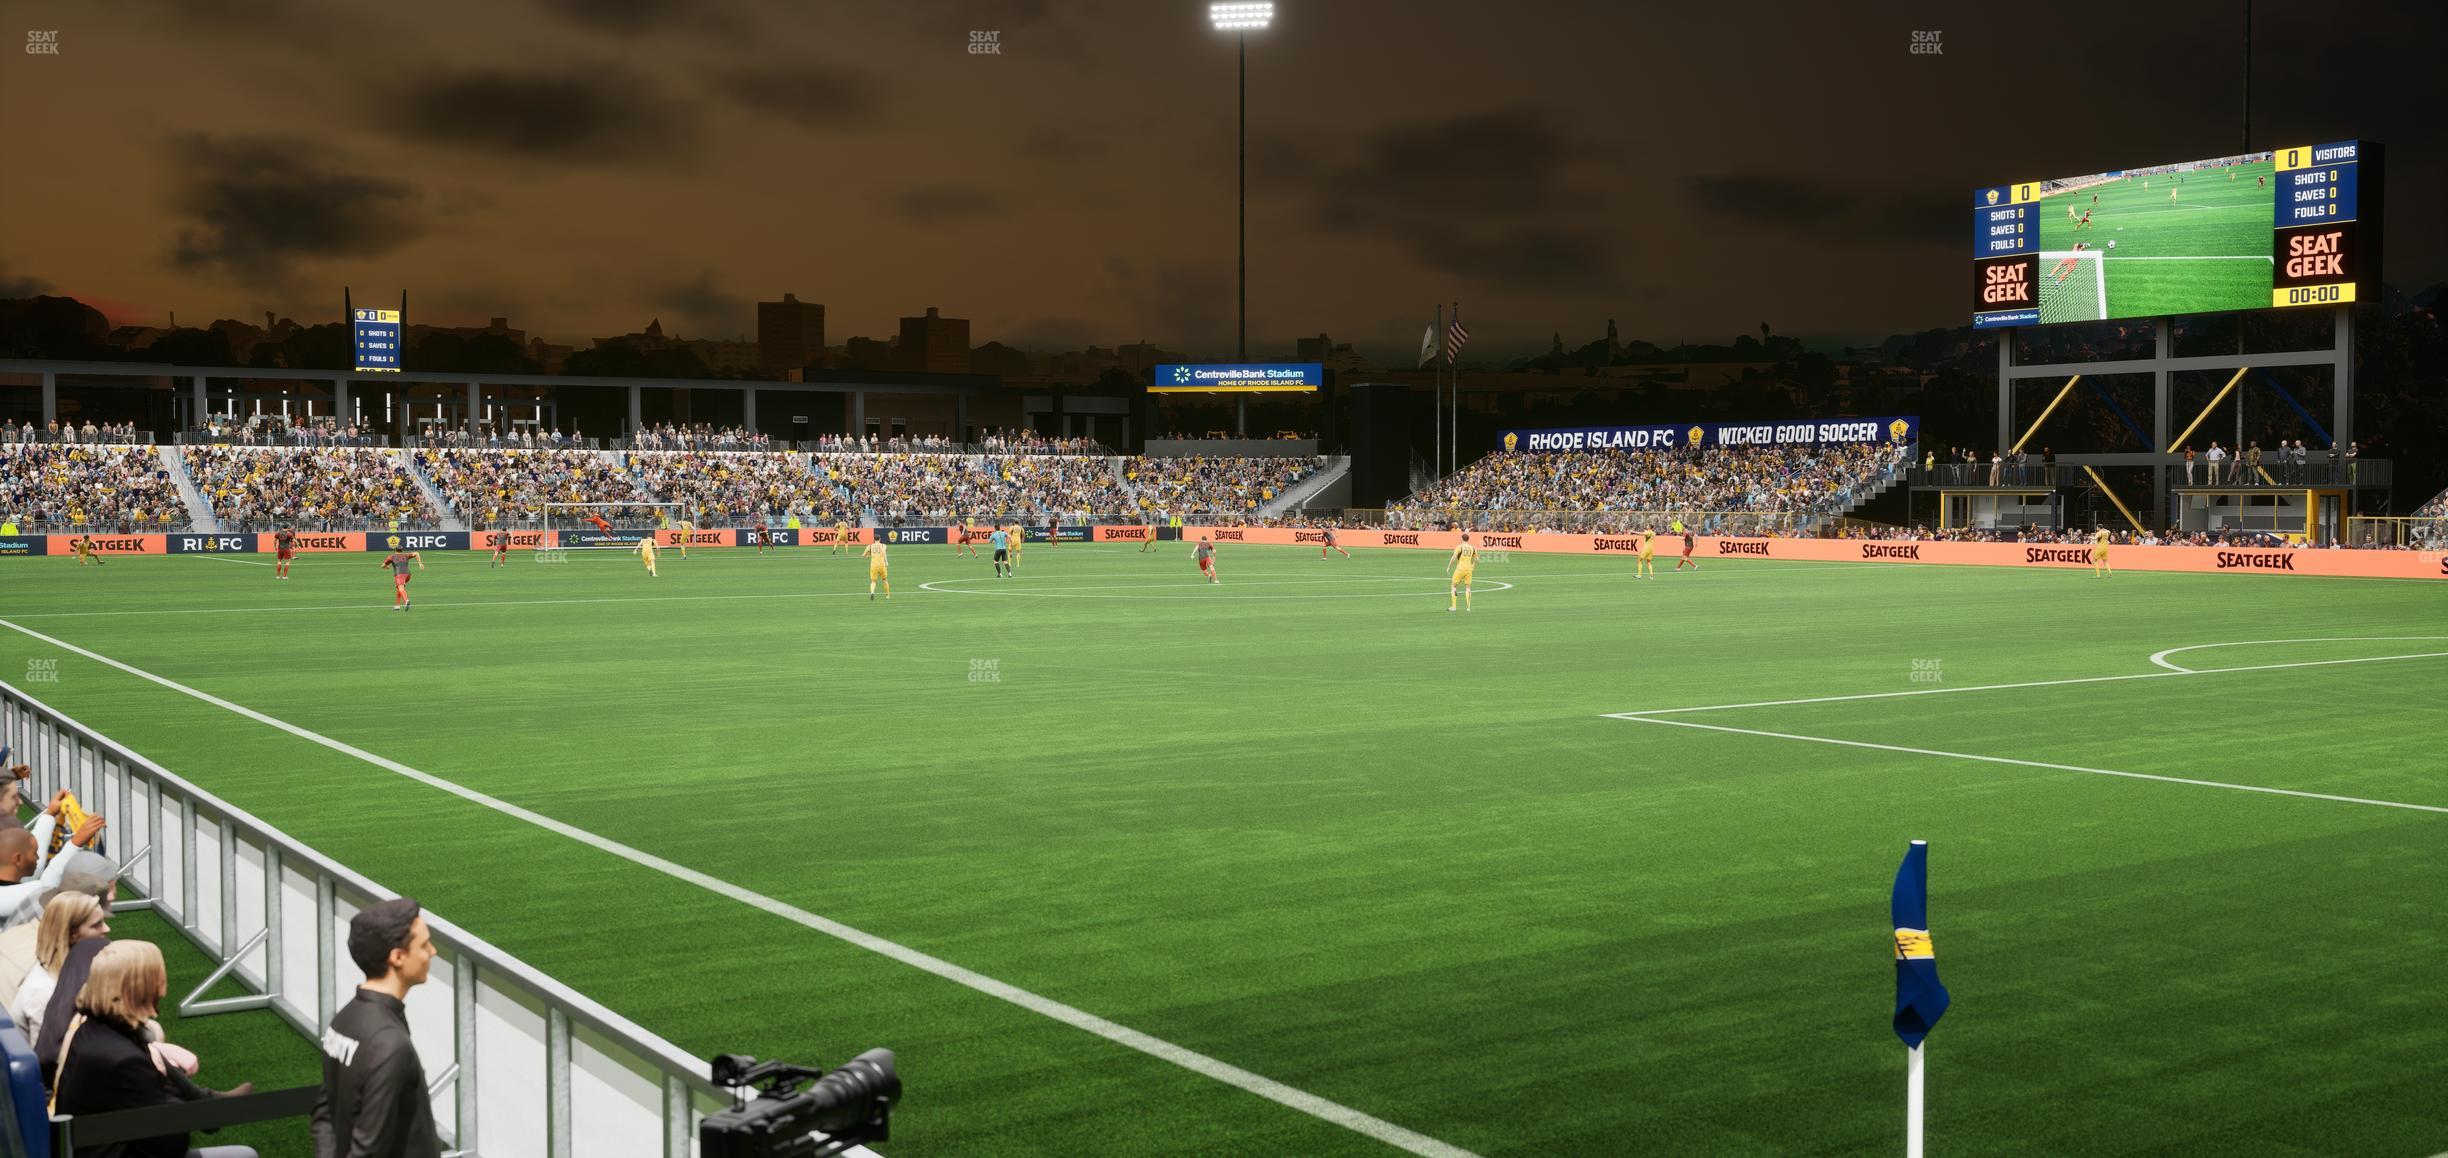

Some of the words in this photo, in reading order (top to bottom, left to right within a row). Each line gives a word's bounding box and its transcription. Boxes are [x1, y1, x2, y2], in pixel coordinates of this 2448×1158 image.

[2288, 150, 2298, 168] 0
[2315, 145, 2356, 161] VISITORS
[2294, 172, 2326, 185] SHOTS
[2330, 170, 2337, 181] 0
[2022, 185, 2030, 201] 0
[2294, 188, 2326, 202] SAVES
[2329, 187, 2337, 198] 0
[1990, 209, 2015, 221] SHOTS
[2018, 208, 2024, 218] 0
[2294, 205, 2326, 219] FOULS
[2329, 203, 2336, 215] 0
[1990, 224, 2015, 236] SAVES
[2018, 223, 2024, 233] 0
[1990, 239, 2015, 251] FOULS
[2017, 238, 2023, 248] 0
[2289, 231, 2343, 257] SEAT
[2286, 253, 2344, 278] GEEK
[1986, 262, 2028, 285] SEAT
[1983, 282, 2029, 303] GEEK
[2289, 285, 2339, 304] 00:00
[1267, 369, 1304, 378] Stadium
[1529, 433, 1585, 450] RHODE
[1586, 430, 1650, 449] ISLAND
[1652, 429, 1675, 447] FC
[1718, 426, 1773, 445] WICKED
[1775, 424, 1816, 444] GOOD
[1818, 422, 1878, 442] SOCCER
[405, 535, 447, 548] RIFC
[901, 530, 930, 542] RIFC
[1105, 528, 1146, 540] SEATGEEK
[1215, 530, 1244, 541] SEATGEEK
[1383, 533, 1419, 546] SEATGEEK
[69, 538, 145, 552] SATGEEK
[183, 538, 203, 550] RI
[219, 537, 242, 550] FC
[1482, 535, 1522, 549] SEATGEEK
[1594, 537, 1638, 552] SEATGEEK
[1719, 541, 1770, 556] SEATGEEK
[1862, 544, 1920, 560] SEATGEEK
[2026, 547, 2092, 565] SEATGEEK
[2217, 551, 2294, 571] SEATGEEK
